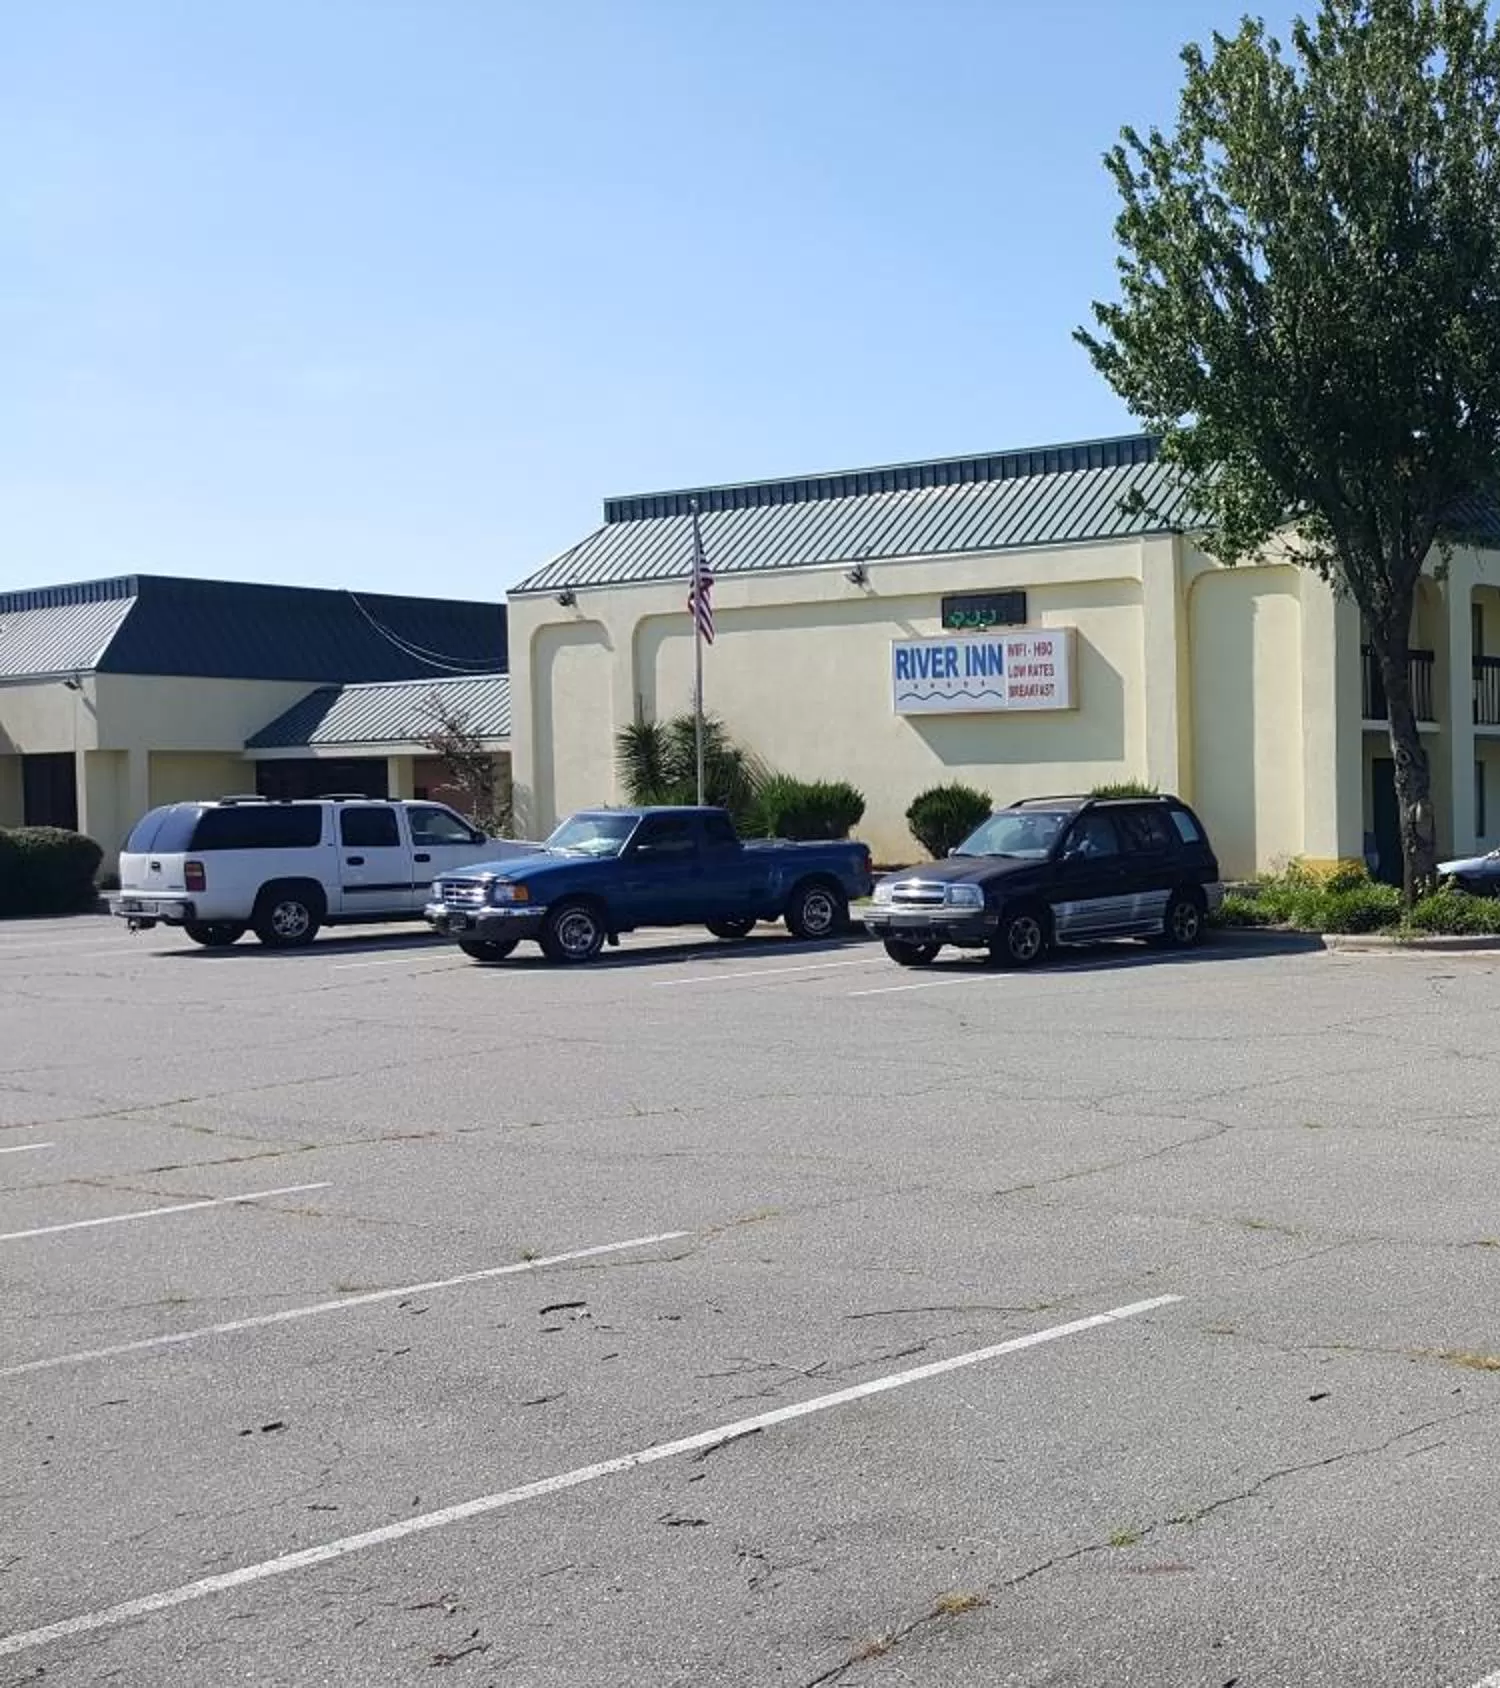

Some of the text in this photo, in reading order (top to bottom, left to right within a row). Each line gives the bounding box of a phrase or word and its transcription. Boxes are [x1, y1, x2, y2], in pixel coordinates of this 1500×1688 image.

[896, 643, 1003, 680] RIVER INN
[1008, 664, 1054, 678] LOW RATES
[1008, 683, 1055, 698] BREAKFAST
